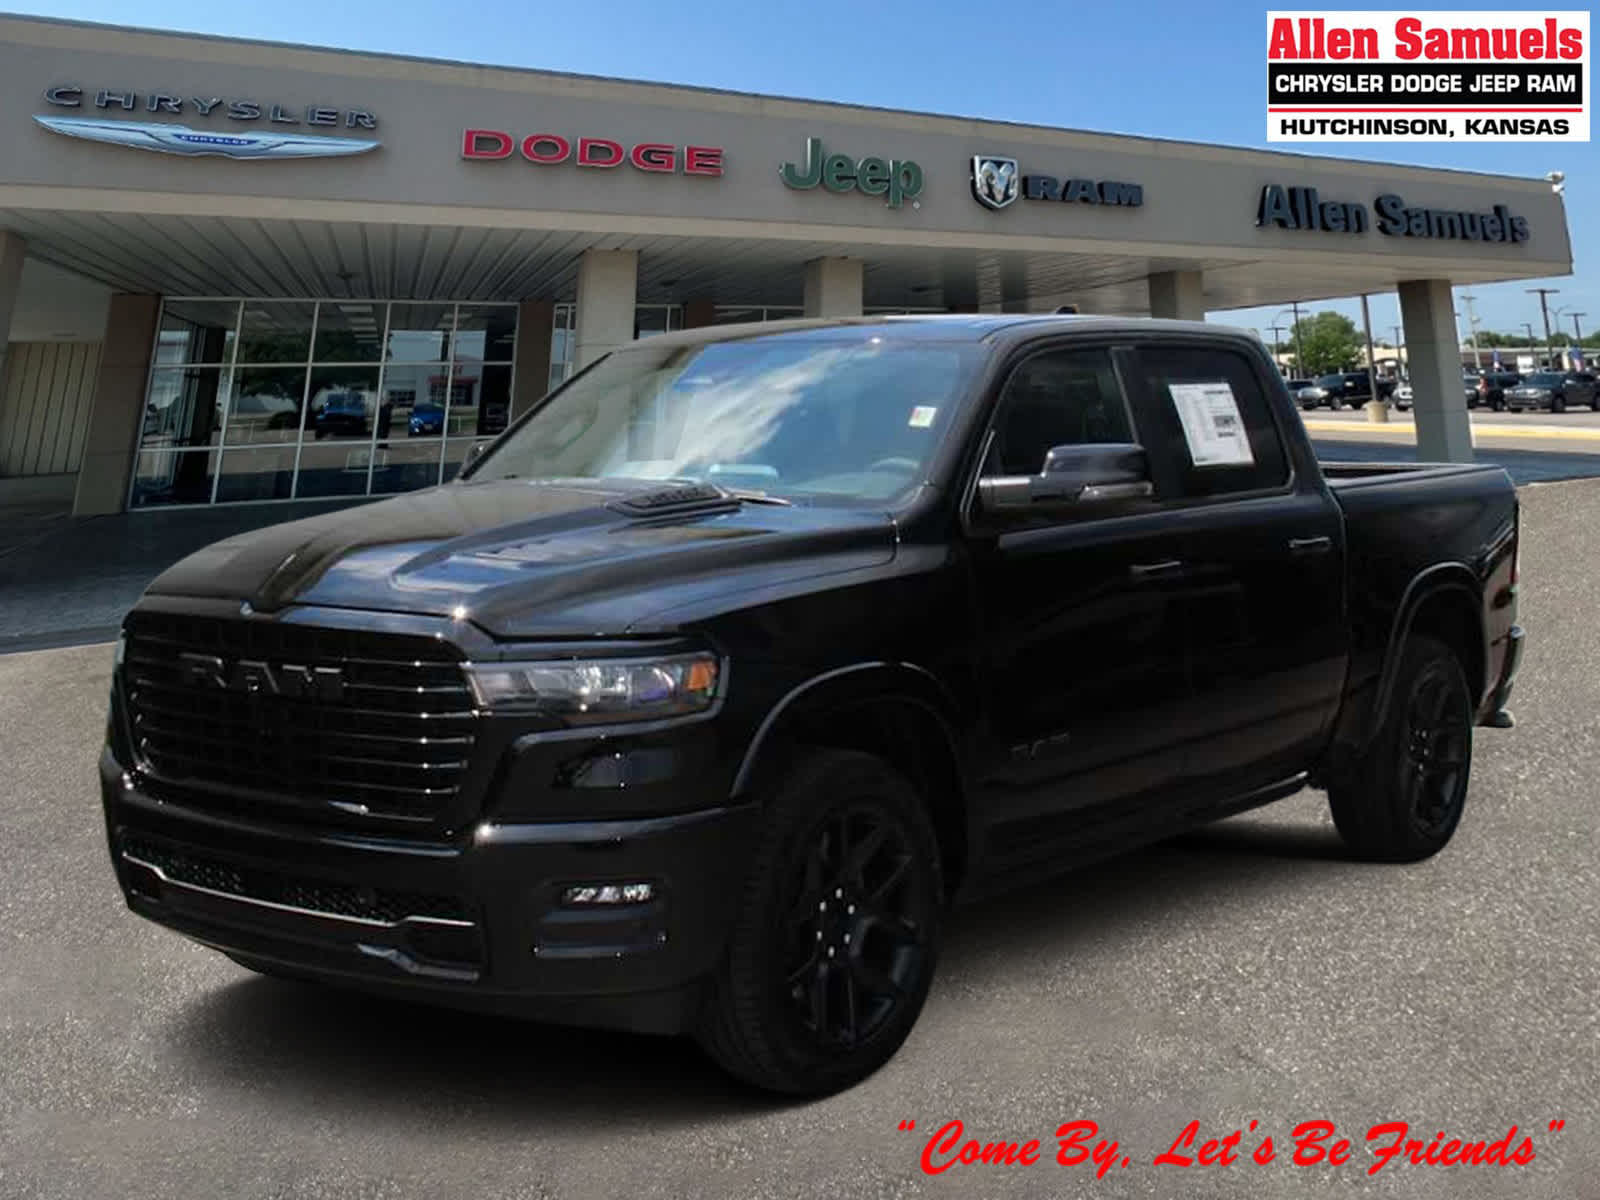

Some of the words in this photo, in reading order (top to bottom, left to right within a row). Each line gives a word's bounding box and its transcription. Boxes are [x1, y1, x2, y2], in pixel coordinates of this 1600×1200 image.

[43, 86, 378, 130] CHRYSLER
[462, 128, 725, 177] DODGE
[778, 136, 924, 209] Jeep
[1023, 175, 1144, 207] RAM
[1255, 184, 1370, 233] Allen
[1374, 193, 1531, 243] Samuels
